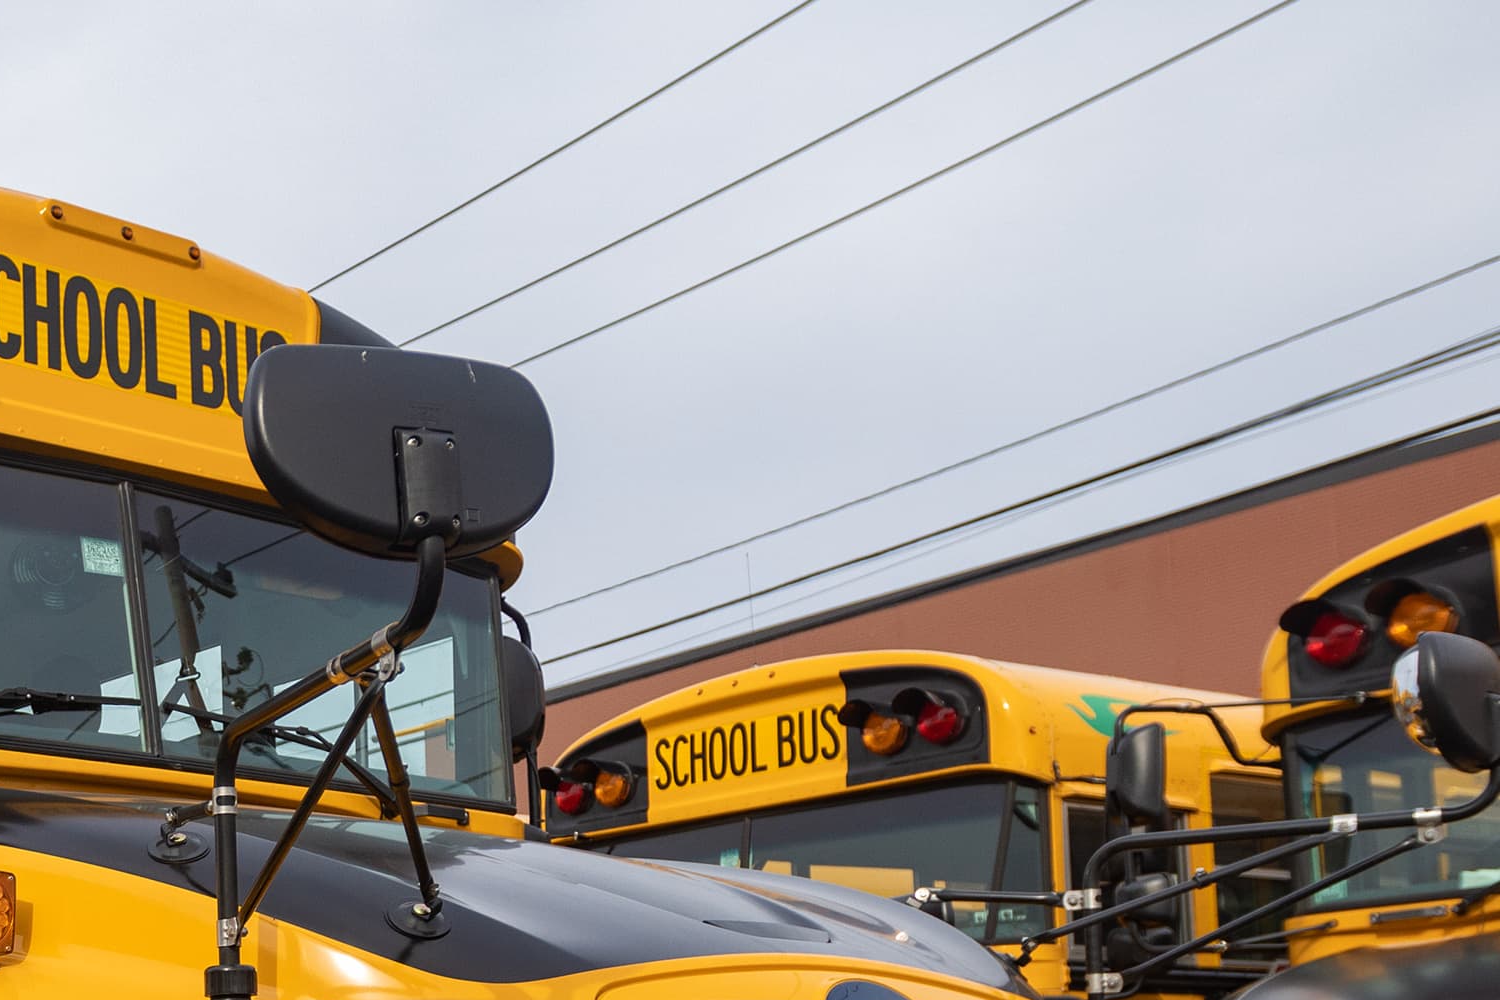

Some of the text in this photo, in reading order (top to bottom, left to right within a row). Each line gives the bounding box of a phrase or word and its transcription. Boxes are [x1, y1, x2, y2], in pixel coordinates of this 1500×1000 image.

[188, 309, 288, 417] BU
[655, 704, 841, 790] SCHOOL BUS
